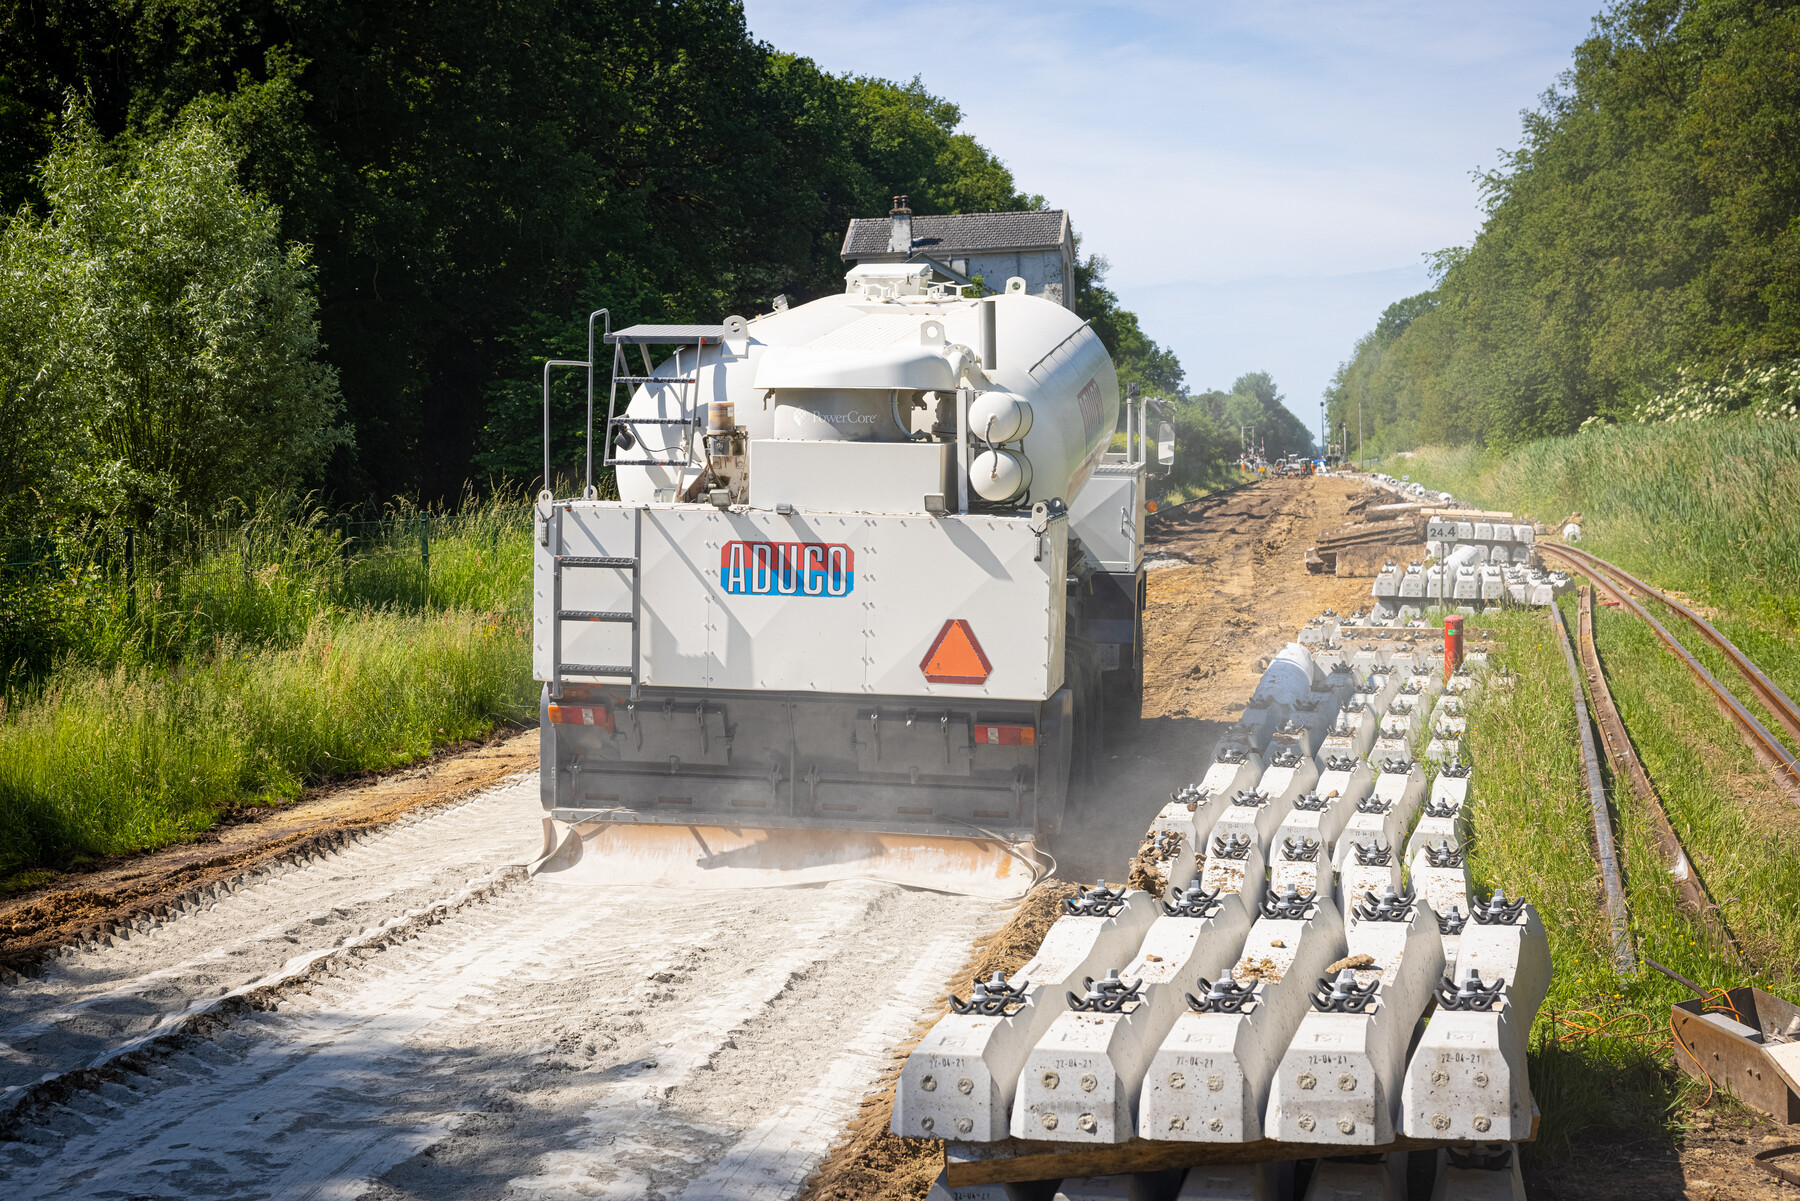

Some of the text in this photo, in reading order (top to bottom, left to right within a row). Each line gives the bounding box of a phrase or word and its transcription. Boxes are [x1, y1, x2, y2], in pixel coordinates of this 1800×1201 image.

[813, 410, 876, 424] PowerCore
[1429, 526, 1456, 538] 24.4
[727, 542, 847, 596] ADUCO
[1441, 1052, 1480, 1063] 22-04-21
